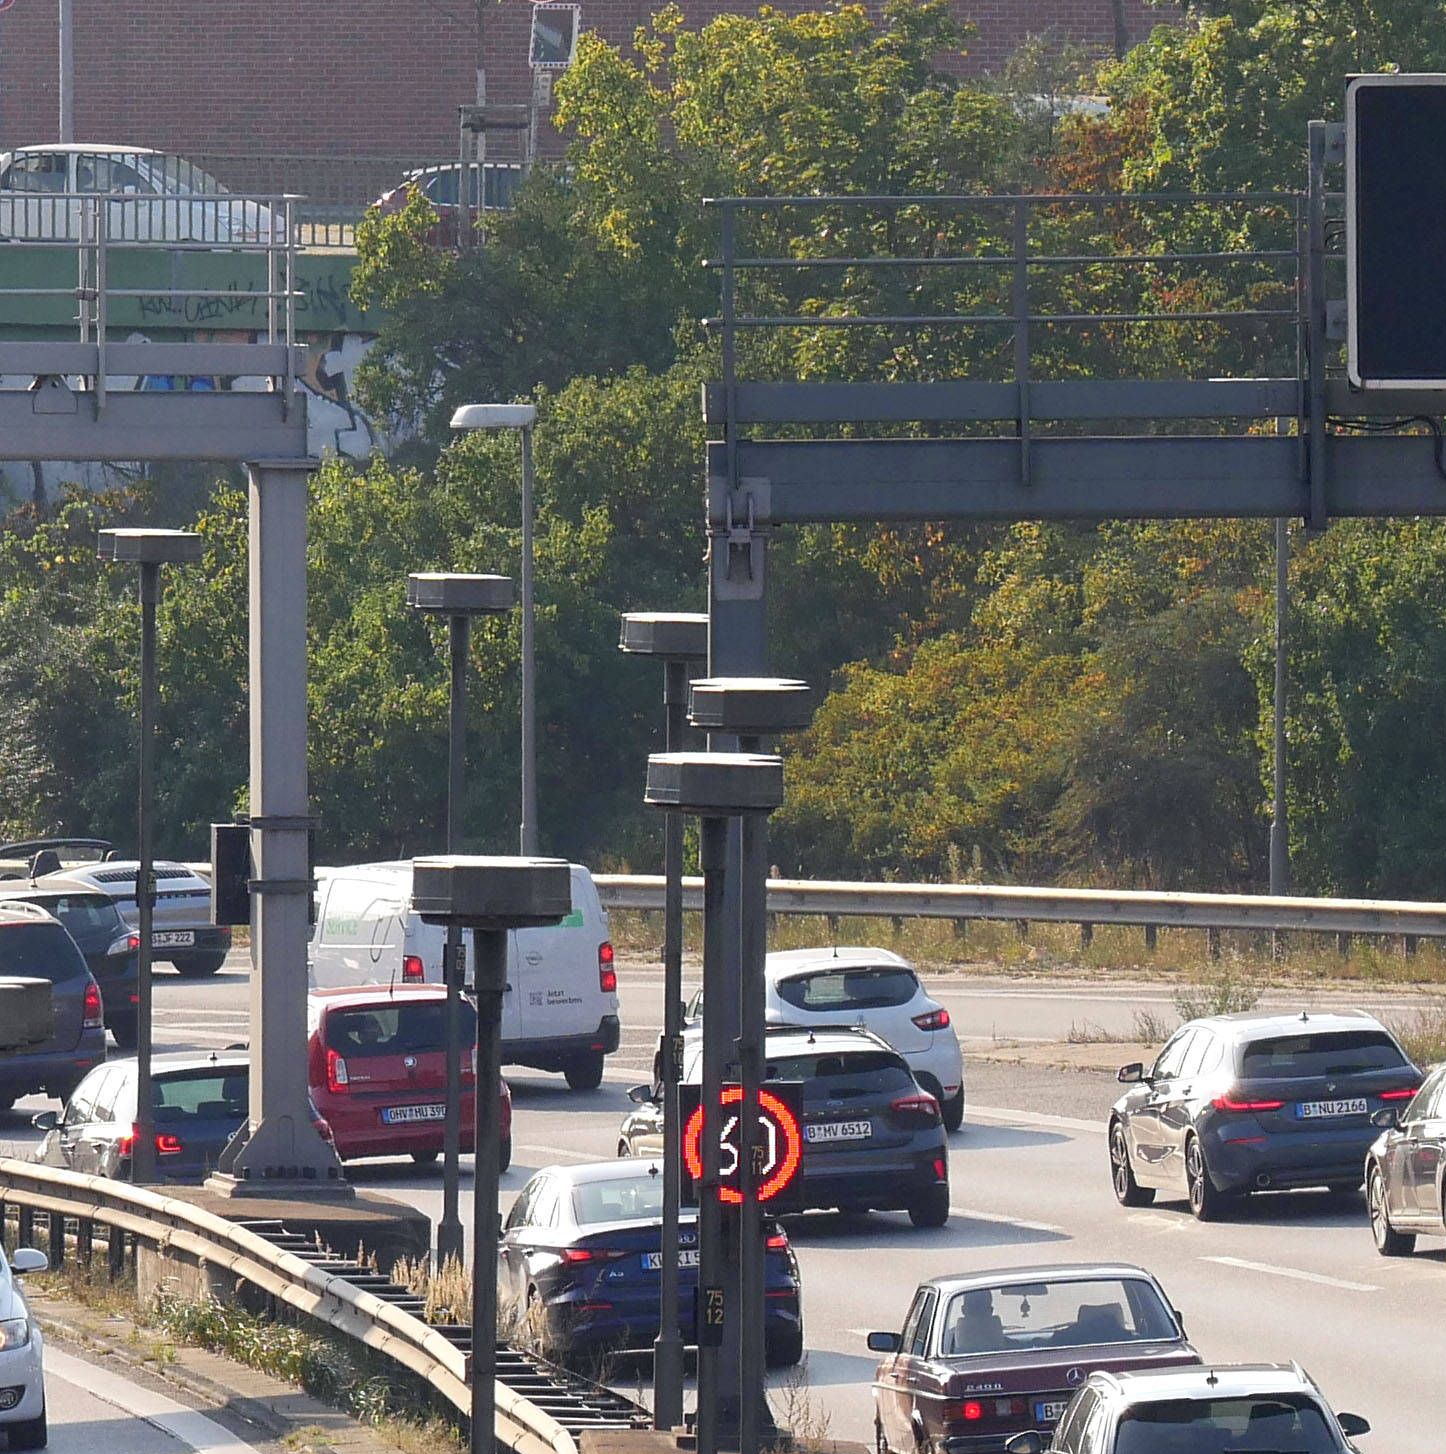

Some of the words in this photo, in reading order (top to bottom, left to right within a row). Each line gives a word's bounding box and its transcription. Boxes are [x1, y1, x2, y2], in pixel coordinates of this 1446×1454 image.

[1304, 1104, 1312, 1115] B
[809, 1127, 816, 1138] B
[841, 1122, 870, 1135] 6512
[706, 1290, 724, 1306] 75
[706, 1309, 724, 1324] 12
[1044, 1404, 1054, 1418] B
